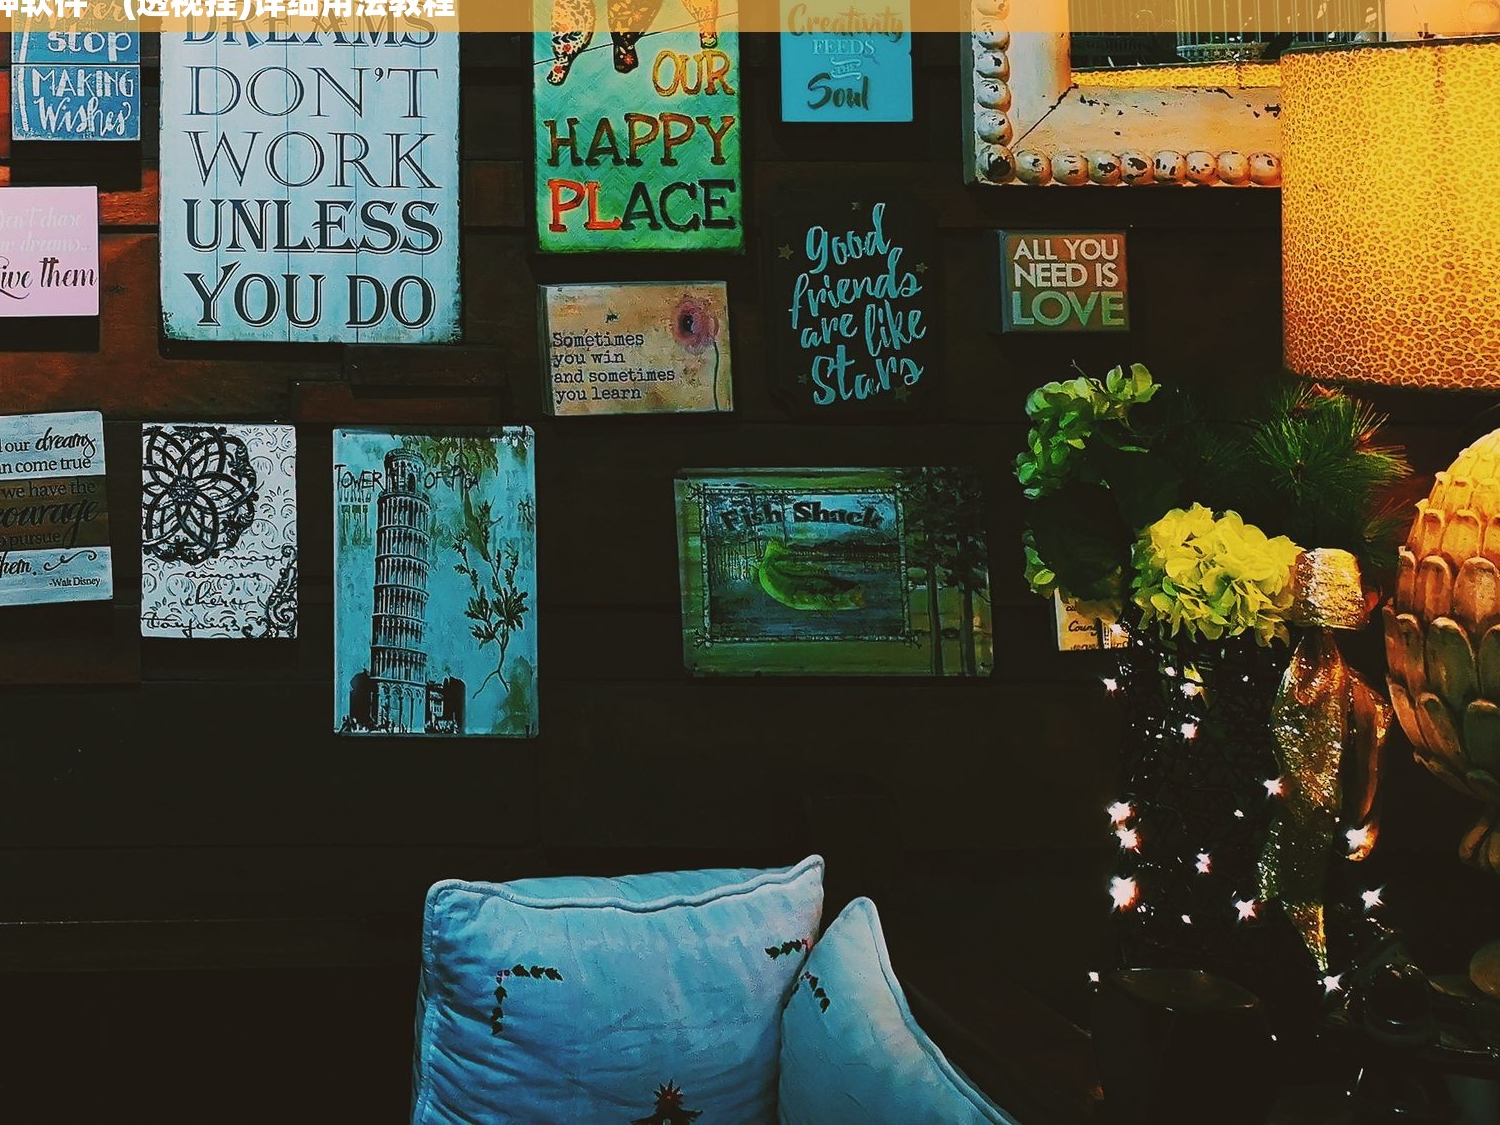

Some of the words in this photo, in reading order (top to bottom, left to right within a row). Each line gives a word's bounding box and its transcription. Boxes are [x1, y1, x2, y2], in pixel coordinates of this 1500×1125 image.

[33, 68, 133, 99] MAKING
[183, 66, 438, 118] DON'T
[36, 98, 131, 136] Wishes
[543, 114, 735, 167] HAPPY
[187, 131, 442, 189] WORK
[547, 179, 735, 233] PLACE
[806, 202, 891, 273] good
[1014, 239, 1061, 261] ALL
[1069, 240, 1119, 260] YOU
[40, 257, 97, 289] them
[1014, 264, 1088, 287] NEED
[1095, 265, 1118, 287] IS
[1014, 291, 1125, 326] LOVE
[554, 331, 644, 349] Sometimes
[556, 386, 588, 402] you
[591, 386, 642, 400] learn
[5, 441, 29, 453] our
[35, 429, 95, 458] dreams
[16, 460, 57, 473] come
[61, 458, 91, 471] true
[722, 505, 783, 531] Fish
[793, 502, 884, 529] Shack
